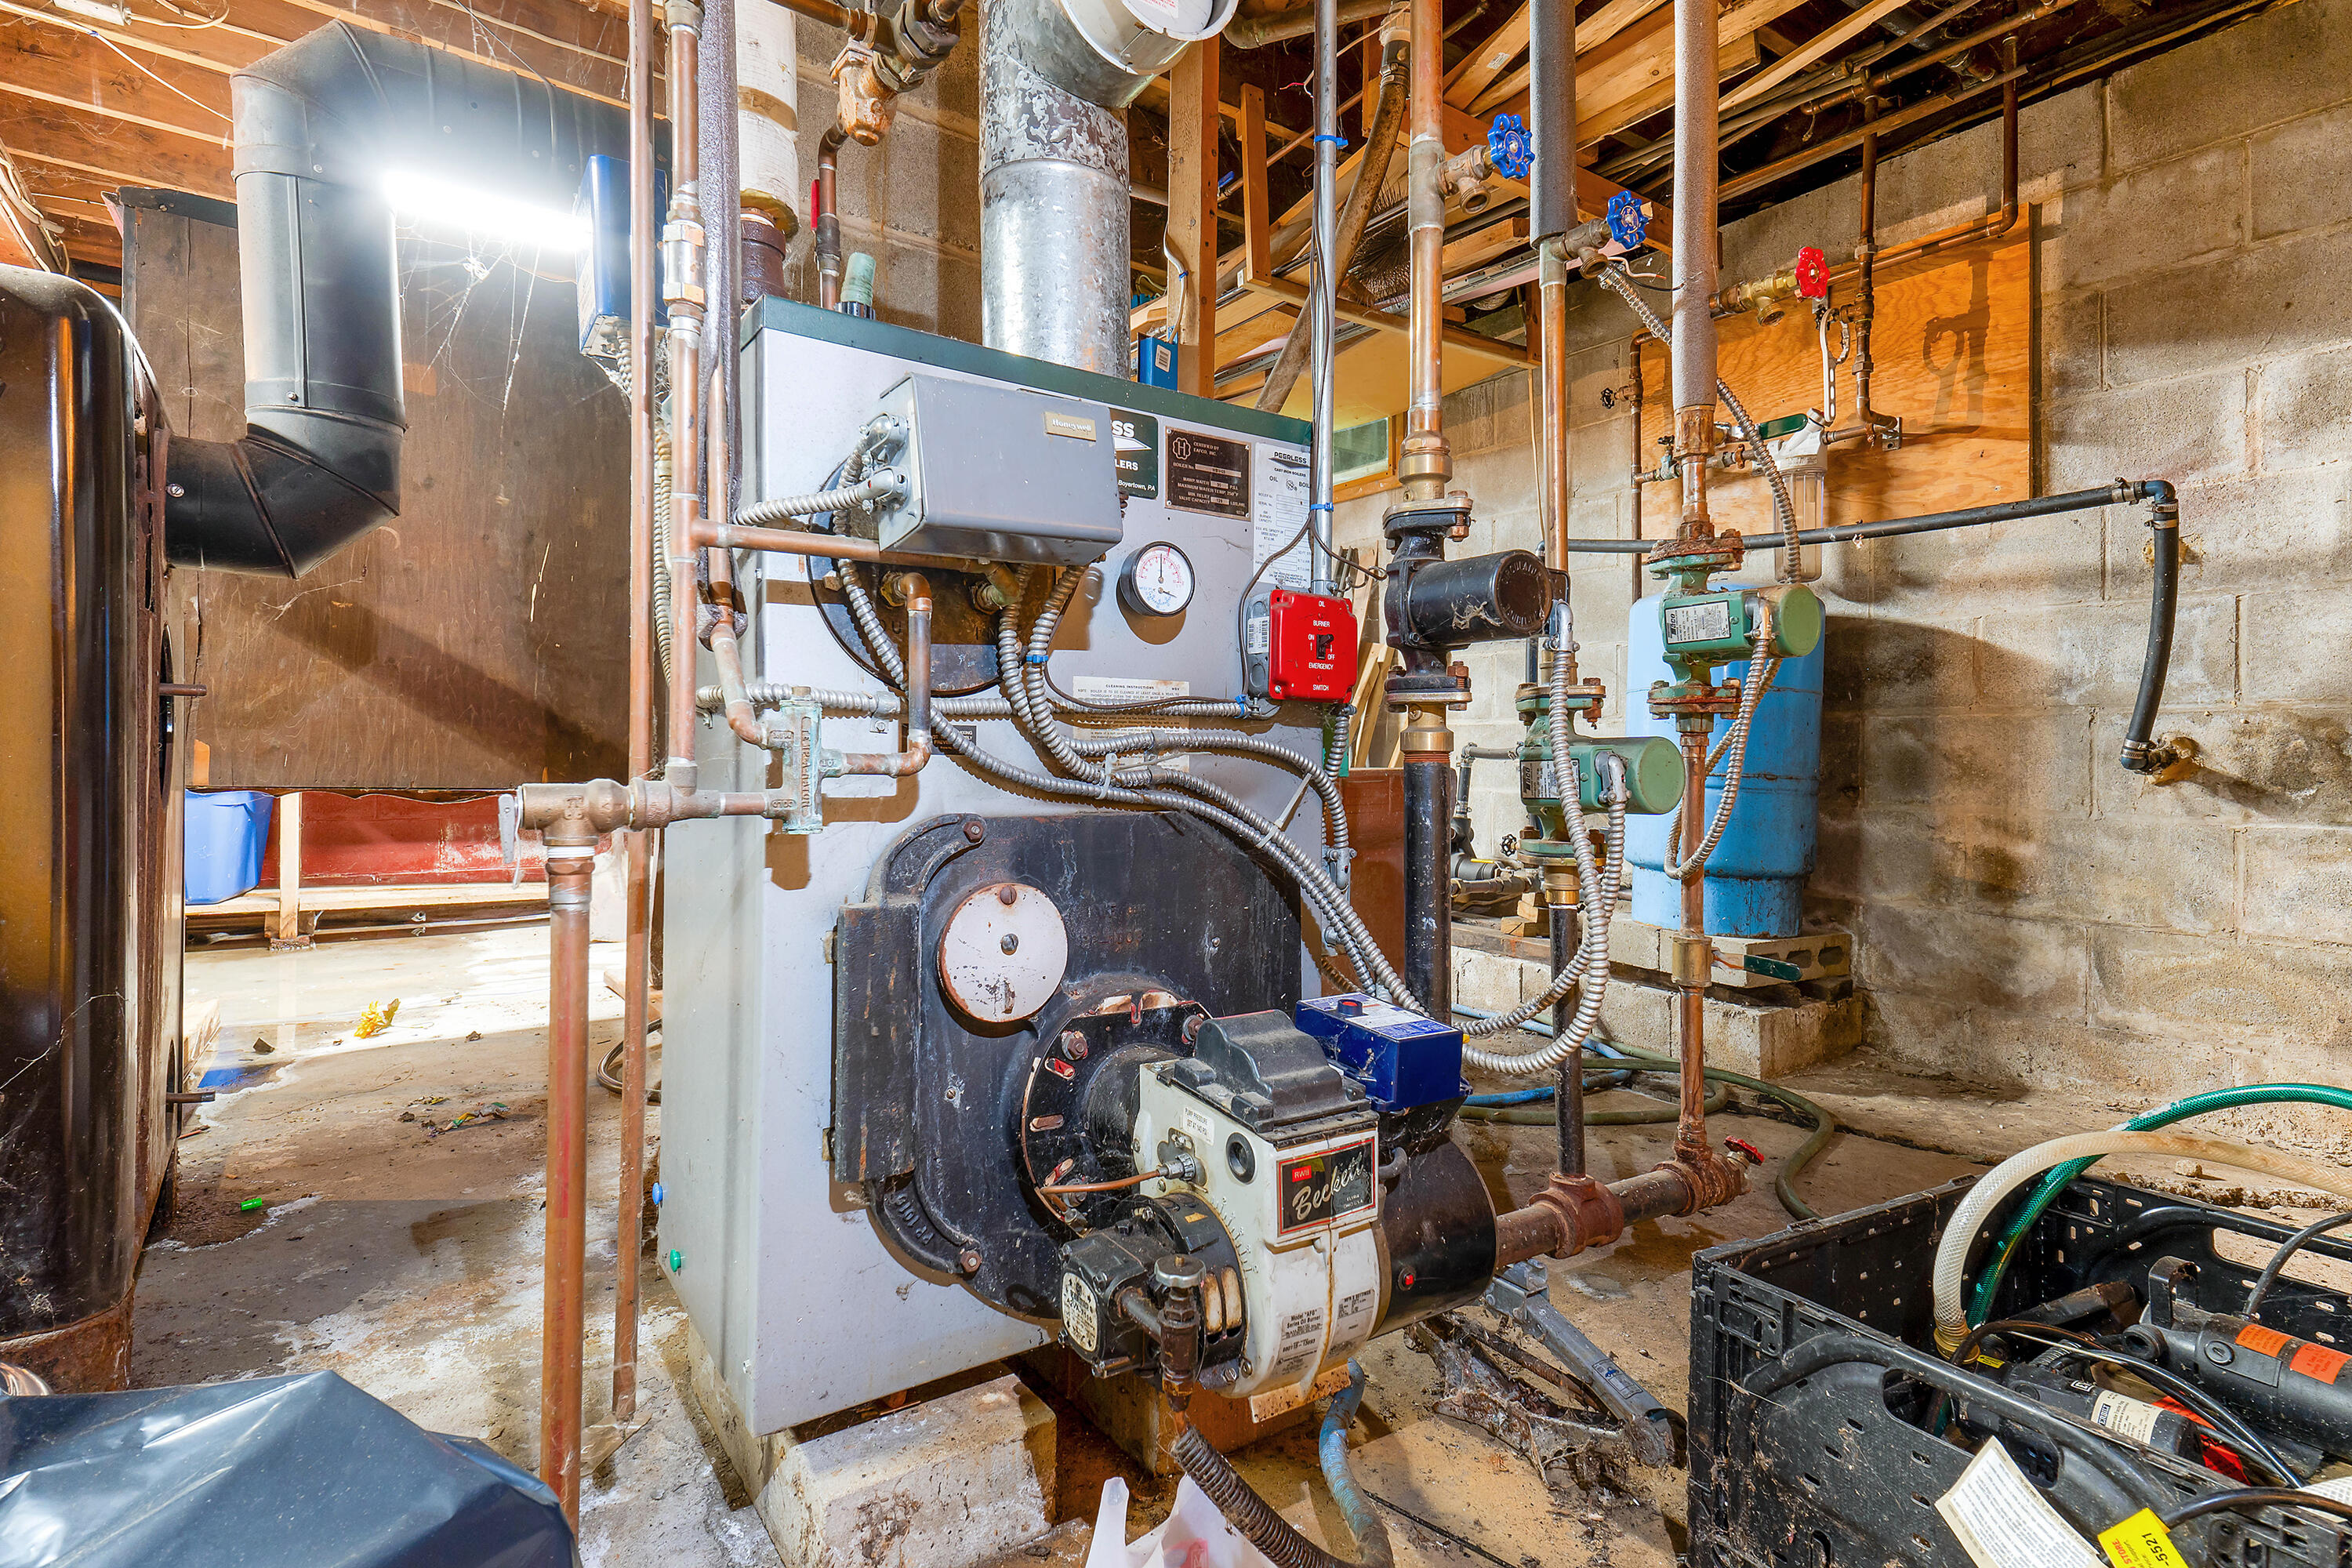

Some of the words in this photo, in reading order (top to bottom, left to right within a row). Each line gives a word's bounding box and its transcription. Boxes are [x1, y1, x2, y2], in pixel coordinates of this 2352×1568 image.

[1052, 419, 1091, 431] Honeywell
[1274, 452, 1307, 463] PEERLESS
[1118, 480, 1146, 491] Boyertown,
[1193, 1112, 1208, 1125] PRESSURE
[1292, 1151, 1363, 1221] Beckett
[1287, 1320, 1300, 1329] Series
[2112, 1538, 2132, 1565] STORE
[2141, 1533, 2169, 1566] -5521
